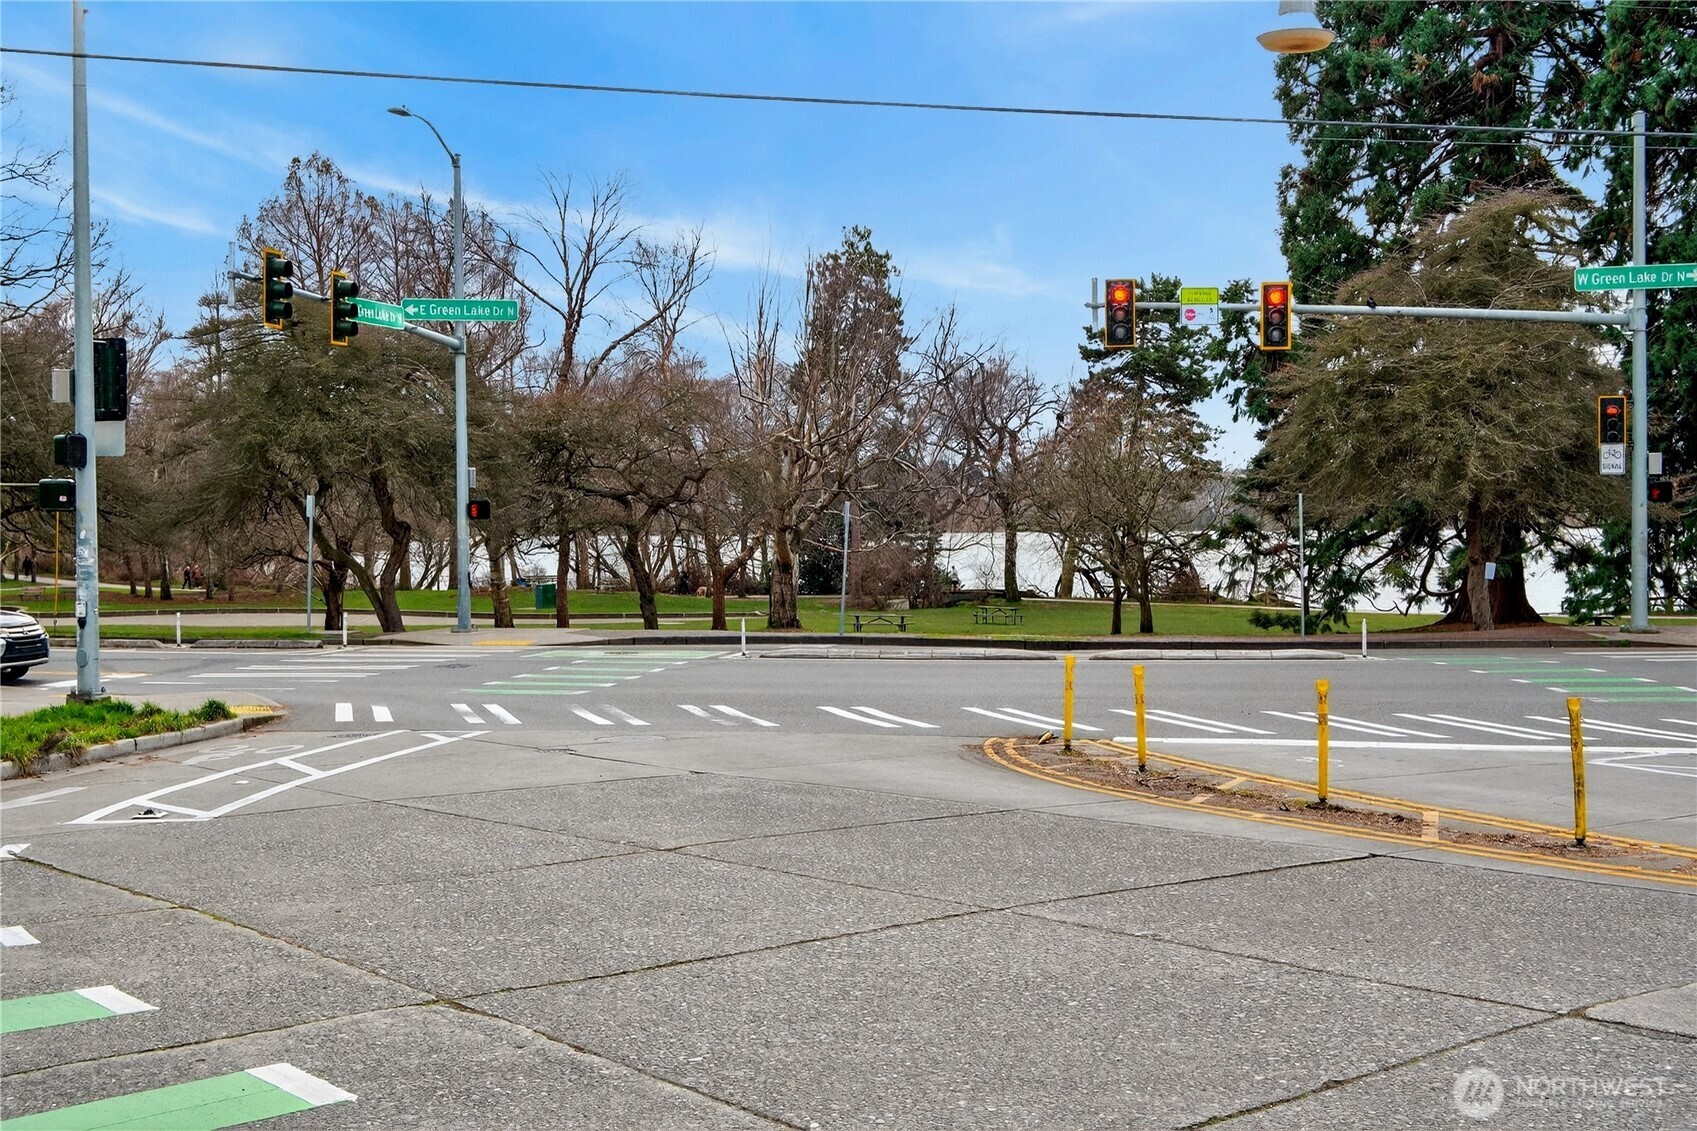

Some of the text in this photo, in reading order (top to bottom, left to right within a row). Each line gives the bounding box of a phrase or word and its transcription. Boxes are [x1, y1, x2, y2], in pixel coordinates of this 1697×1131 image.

[1578, 271, 1685, 285] W Green Lake Dr N
[420, 304, 514, 316] E Green Lake Dr N
